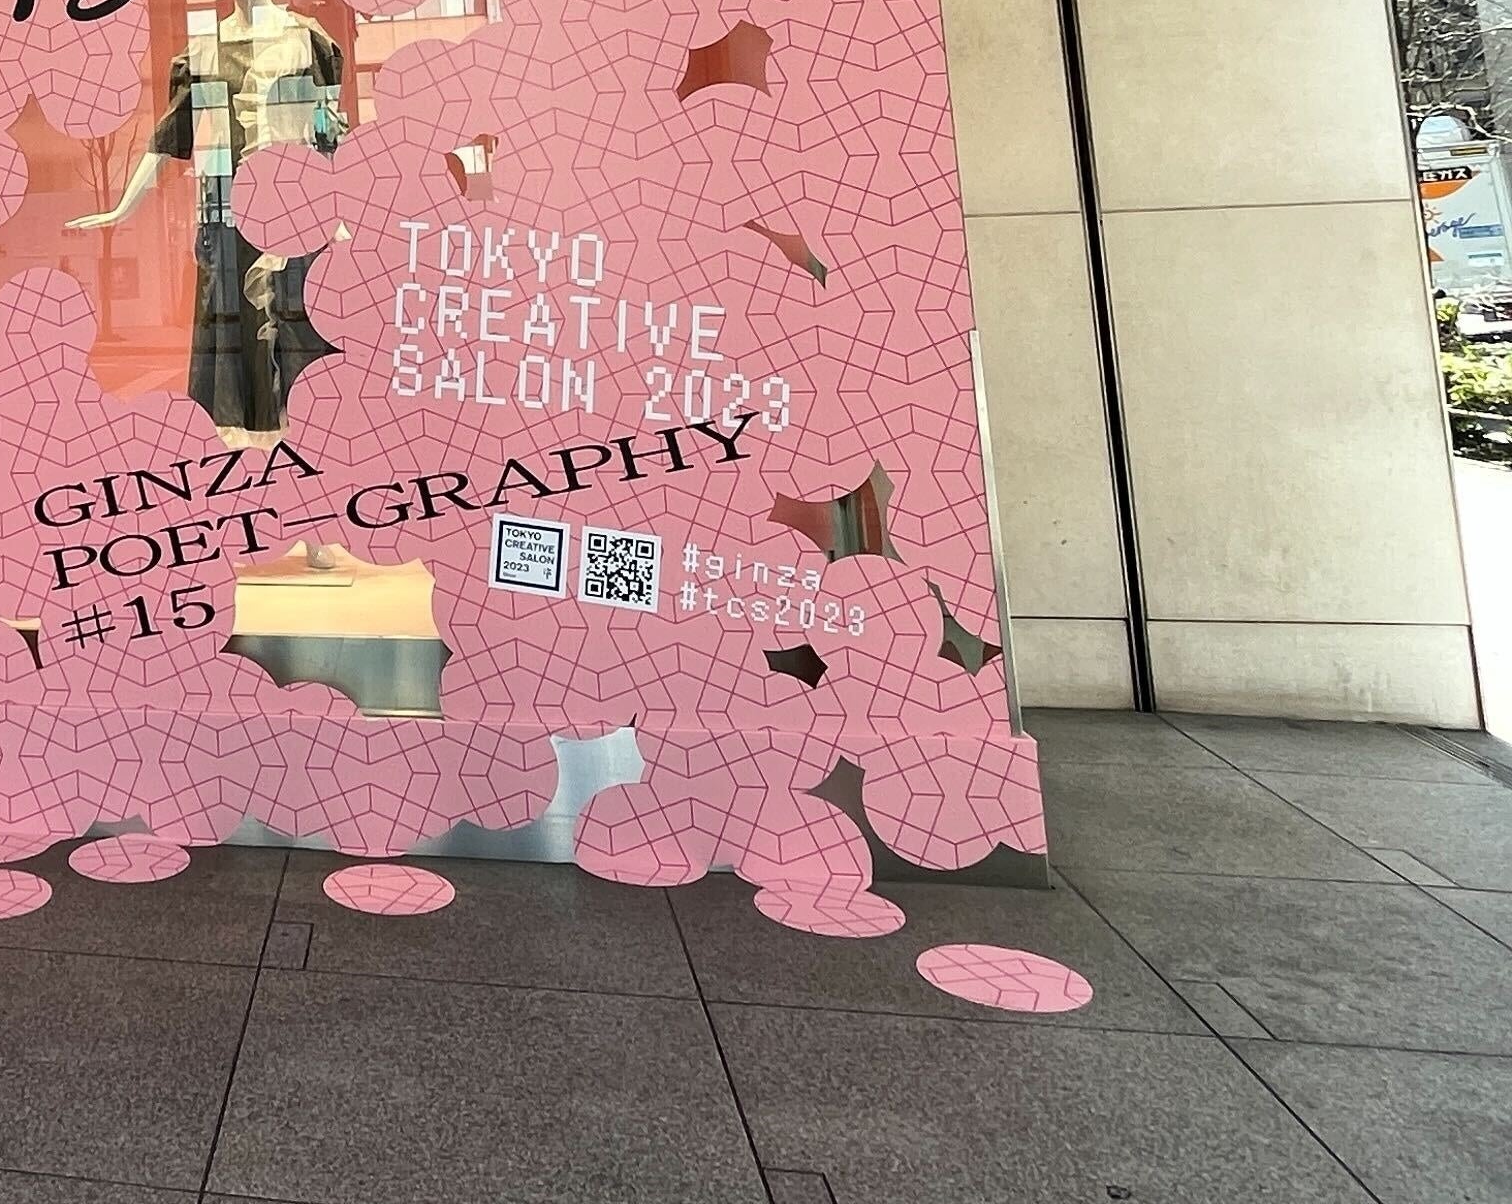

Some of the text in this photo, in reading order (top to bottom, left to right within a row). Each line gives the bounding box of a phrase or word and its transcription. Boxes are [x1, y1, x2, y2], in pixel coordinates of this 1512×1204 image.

[399, 221, 604, 287] TOKYO
[394, 283, 726, 361] CREATIVE
[392, 344, 789, 432] SALON 2023
[34, 440, 324, 528] GINZA
[504, 539, 556, 554] CREATIVE
[506, 527, 542, 541] TOKYO
[519, 551, 555, 565] SALON
[503, 560, 530, 573] 2023
[682, 542, 821, 591] #ginza
[61, 584, 216, 649] #15
[680, 581, 865, 637] #tcs2023
